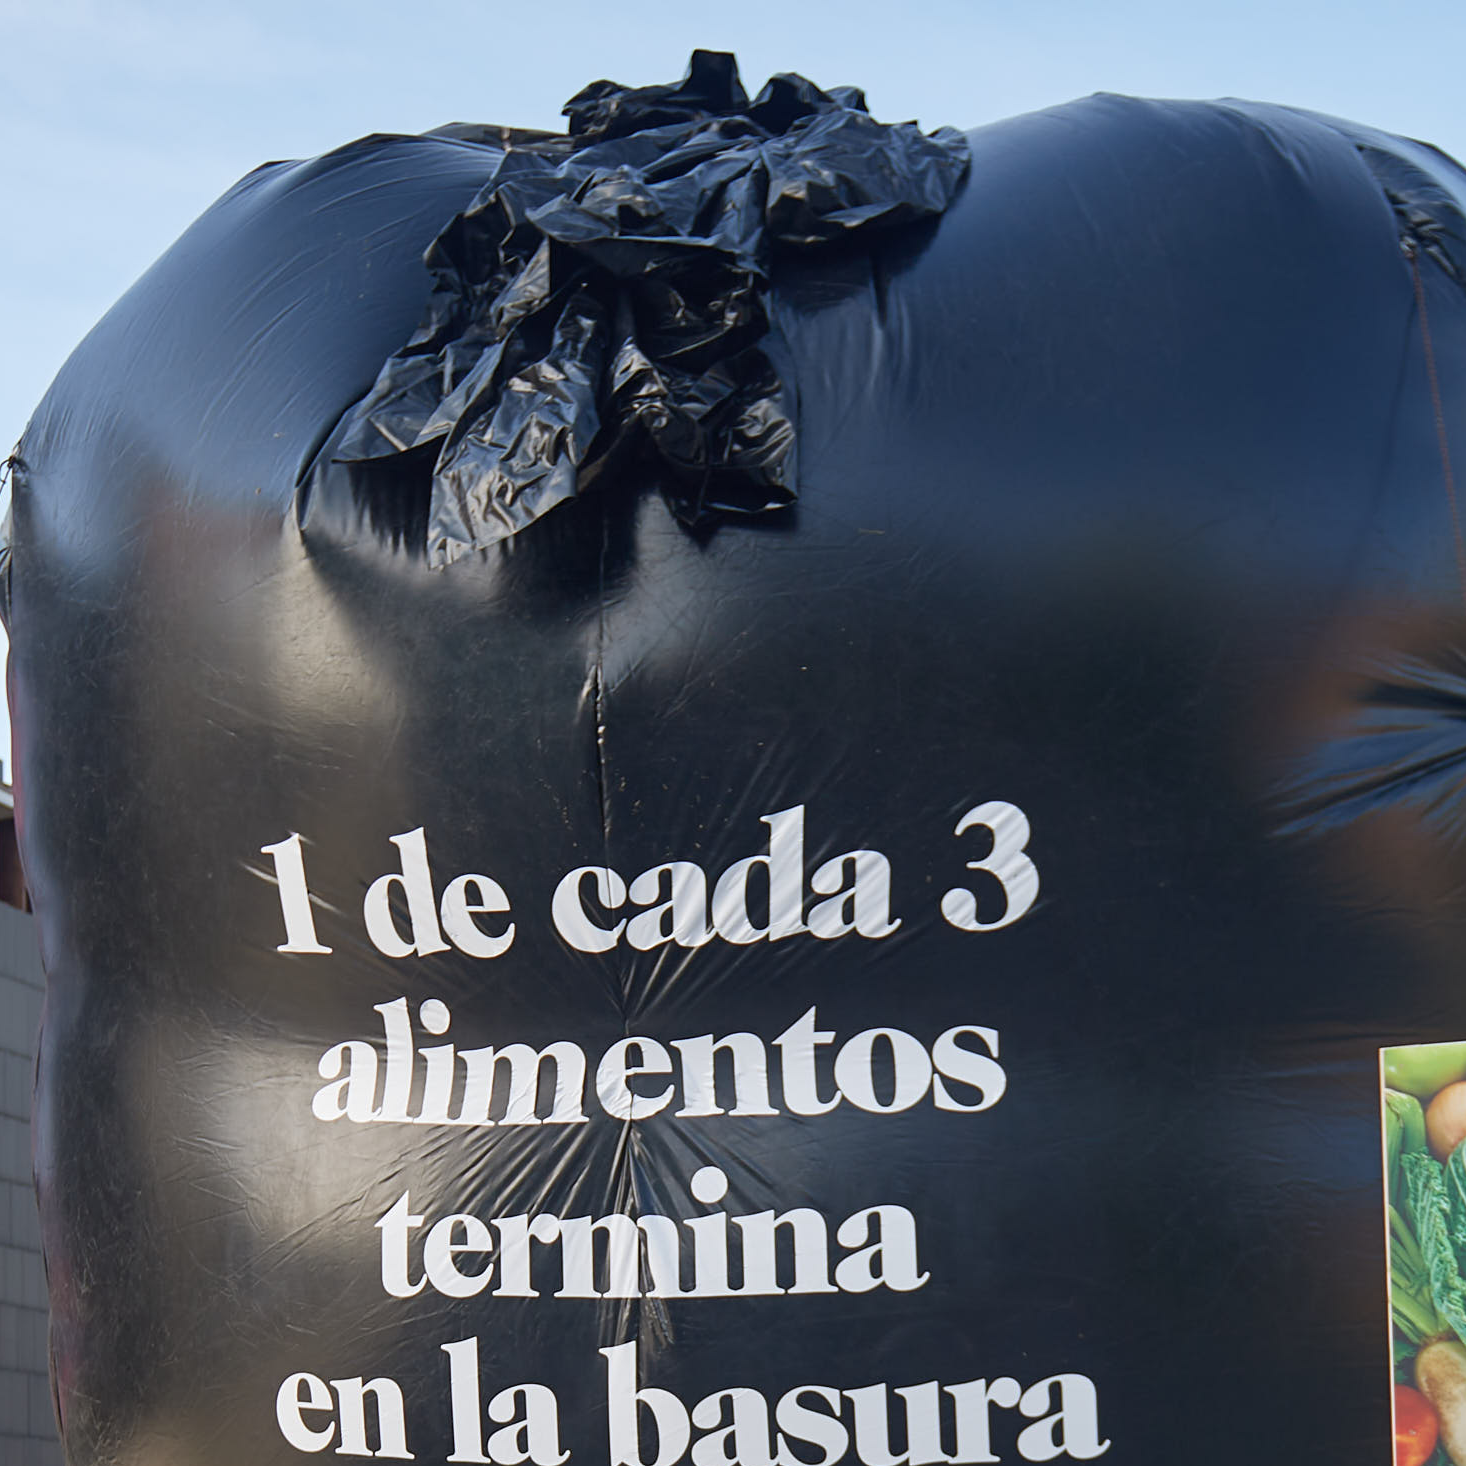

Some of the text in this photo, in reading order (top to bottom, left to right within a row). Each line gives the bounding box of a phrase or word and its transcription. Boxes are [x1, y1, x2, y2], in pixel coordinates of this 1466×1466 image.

[261, 801, 1041, 958] 1 de cada 3
[311, 996, 1007, 1127] alimentos
[375, 1165, 931, 1299] termina
[276, 1371, 414, 1461] en
[441, 1336, 570, 1466] la
